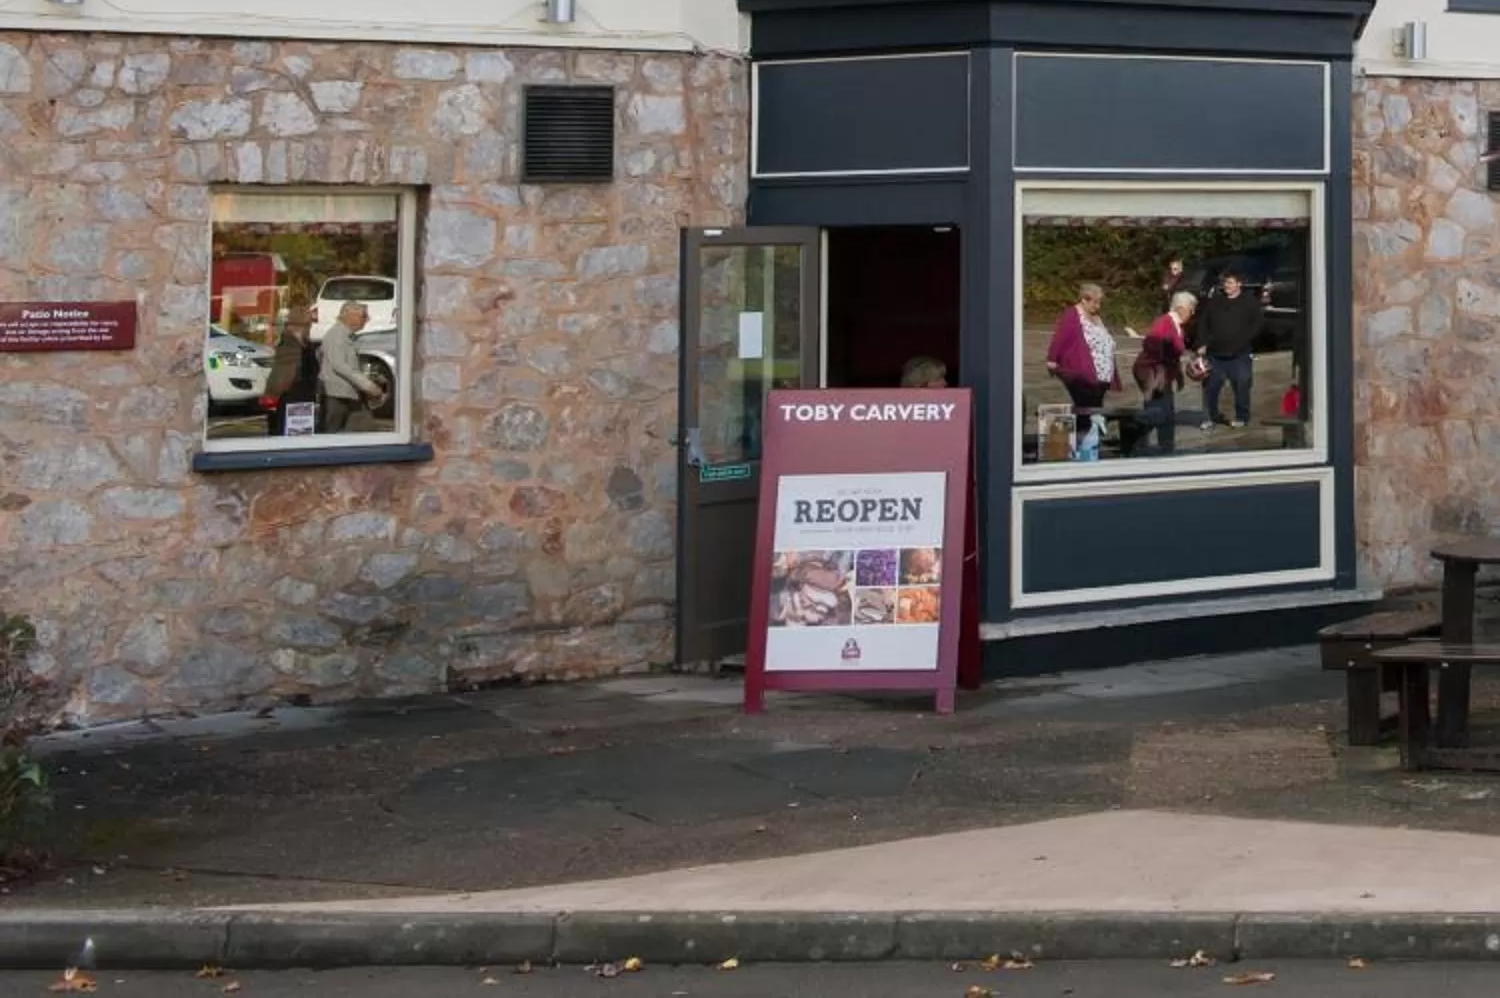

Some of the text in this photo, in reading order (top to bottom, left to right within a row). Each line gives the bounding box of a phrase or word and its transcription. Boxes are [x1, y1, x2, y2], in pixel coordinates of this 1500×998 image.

[780, 403, 955, 422] TOBY CARVERY
[793, 497, 923, 524] REOPEN
